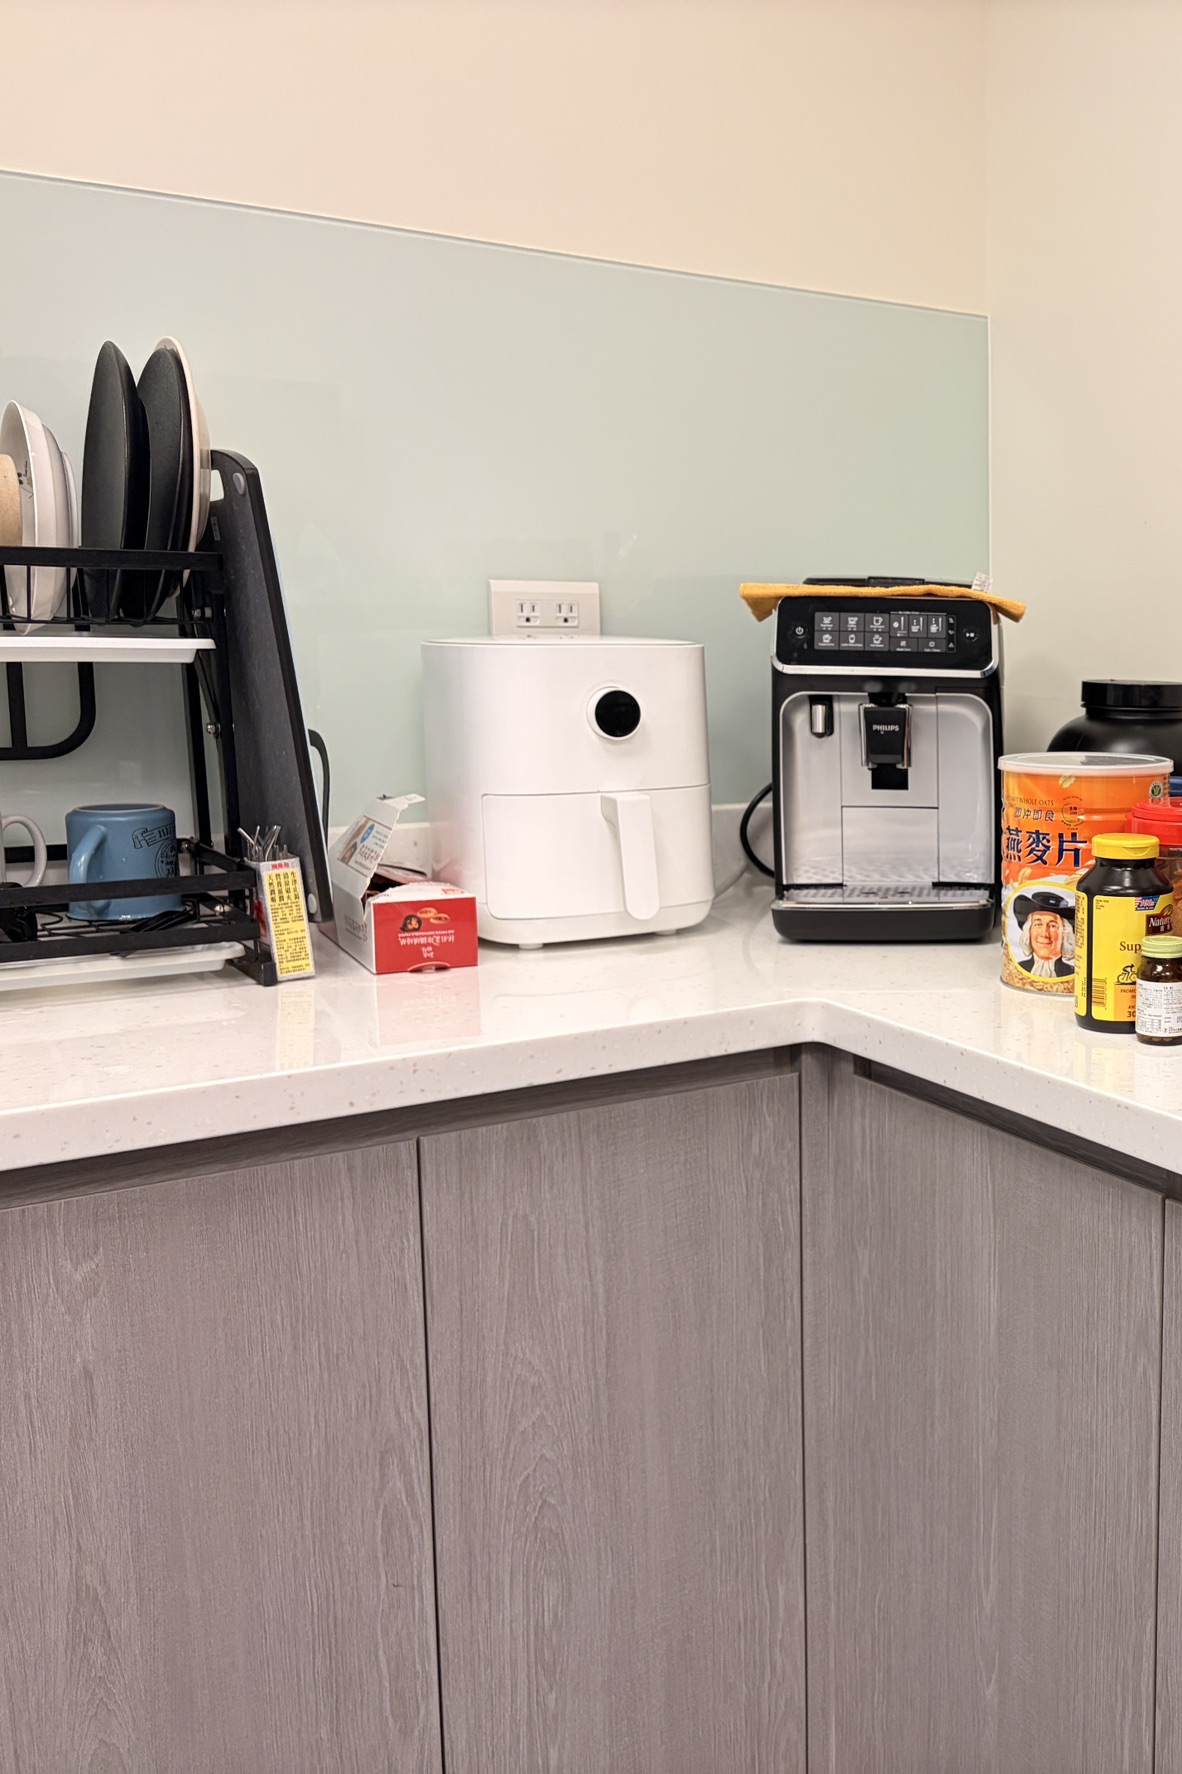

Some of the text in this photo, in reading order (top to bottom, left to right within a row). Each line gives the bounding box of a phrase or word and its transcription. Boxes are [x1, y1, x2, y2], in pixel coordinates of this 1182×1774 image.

[872, 724, 899, 732] PHILIPS
[1039, 799, 1054, 807] OATS
[1014, 806, 1054, 822] 即沖即食
[1006, 825, 1087, 868] 燕麥片
[1119, 941, 1141, 954] Sup
